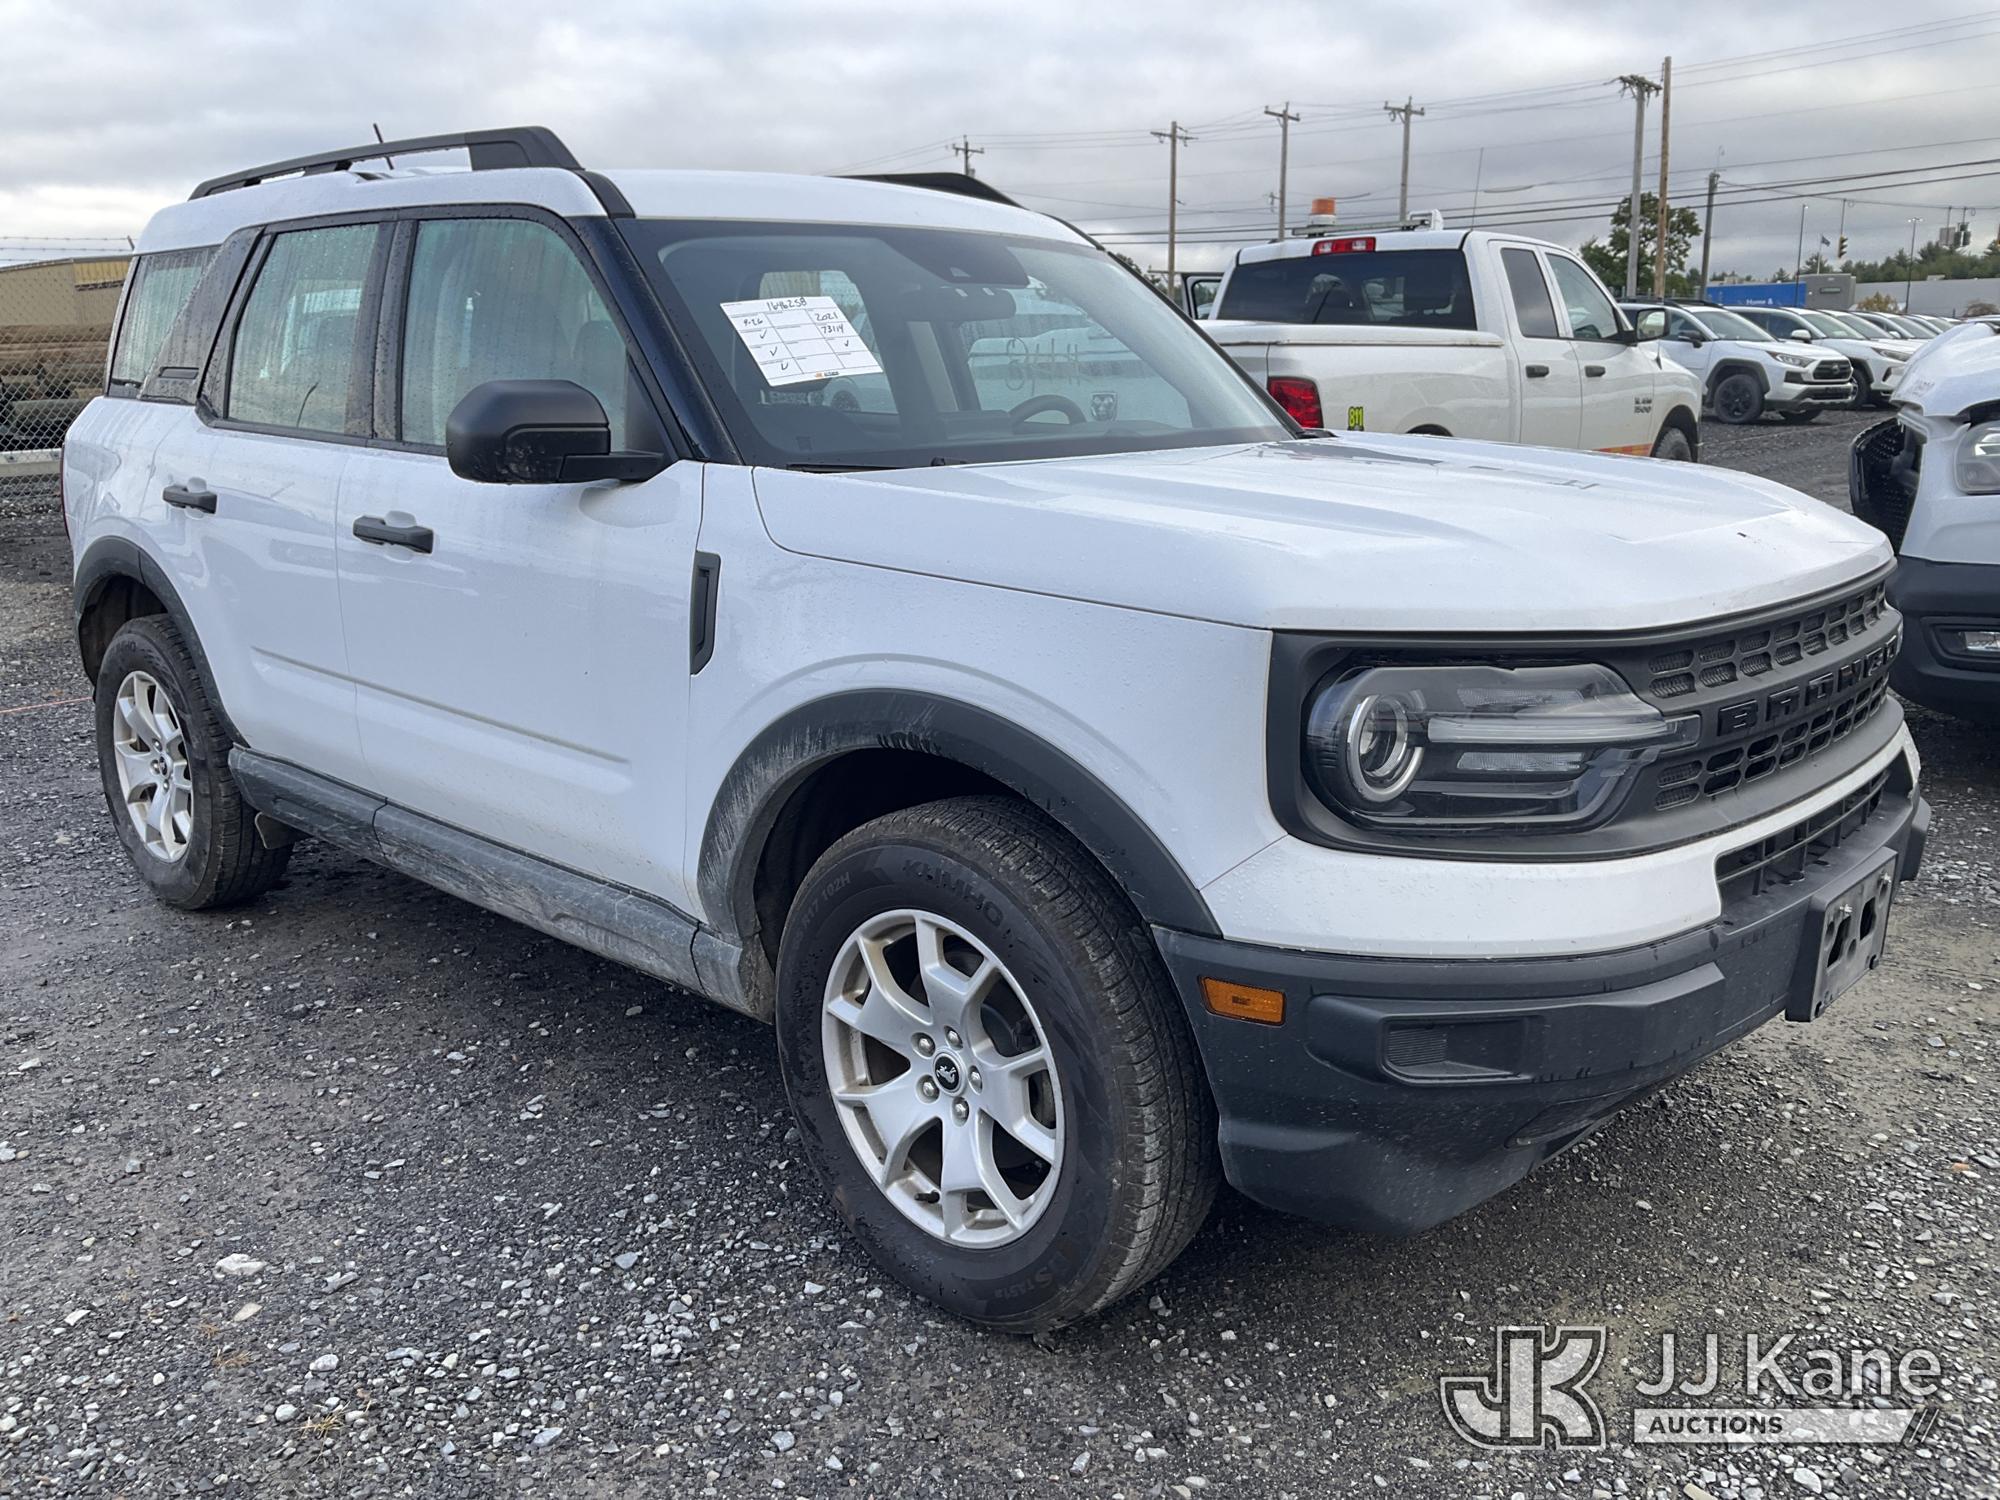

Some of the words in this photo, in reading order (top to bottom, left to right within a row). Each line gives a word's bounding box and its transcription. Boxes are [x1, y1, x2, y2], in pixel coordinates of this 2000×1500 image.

[766, 297, 807, 311] 1646258
[815, 312, 839, 322] 2021
[1349, 406, 1363, 427] 811
[1716, 634, 1898, 736] BRONCO
